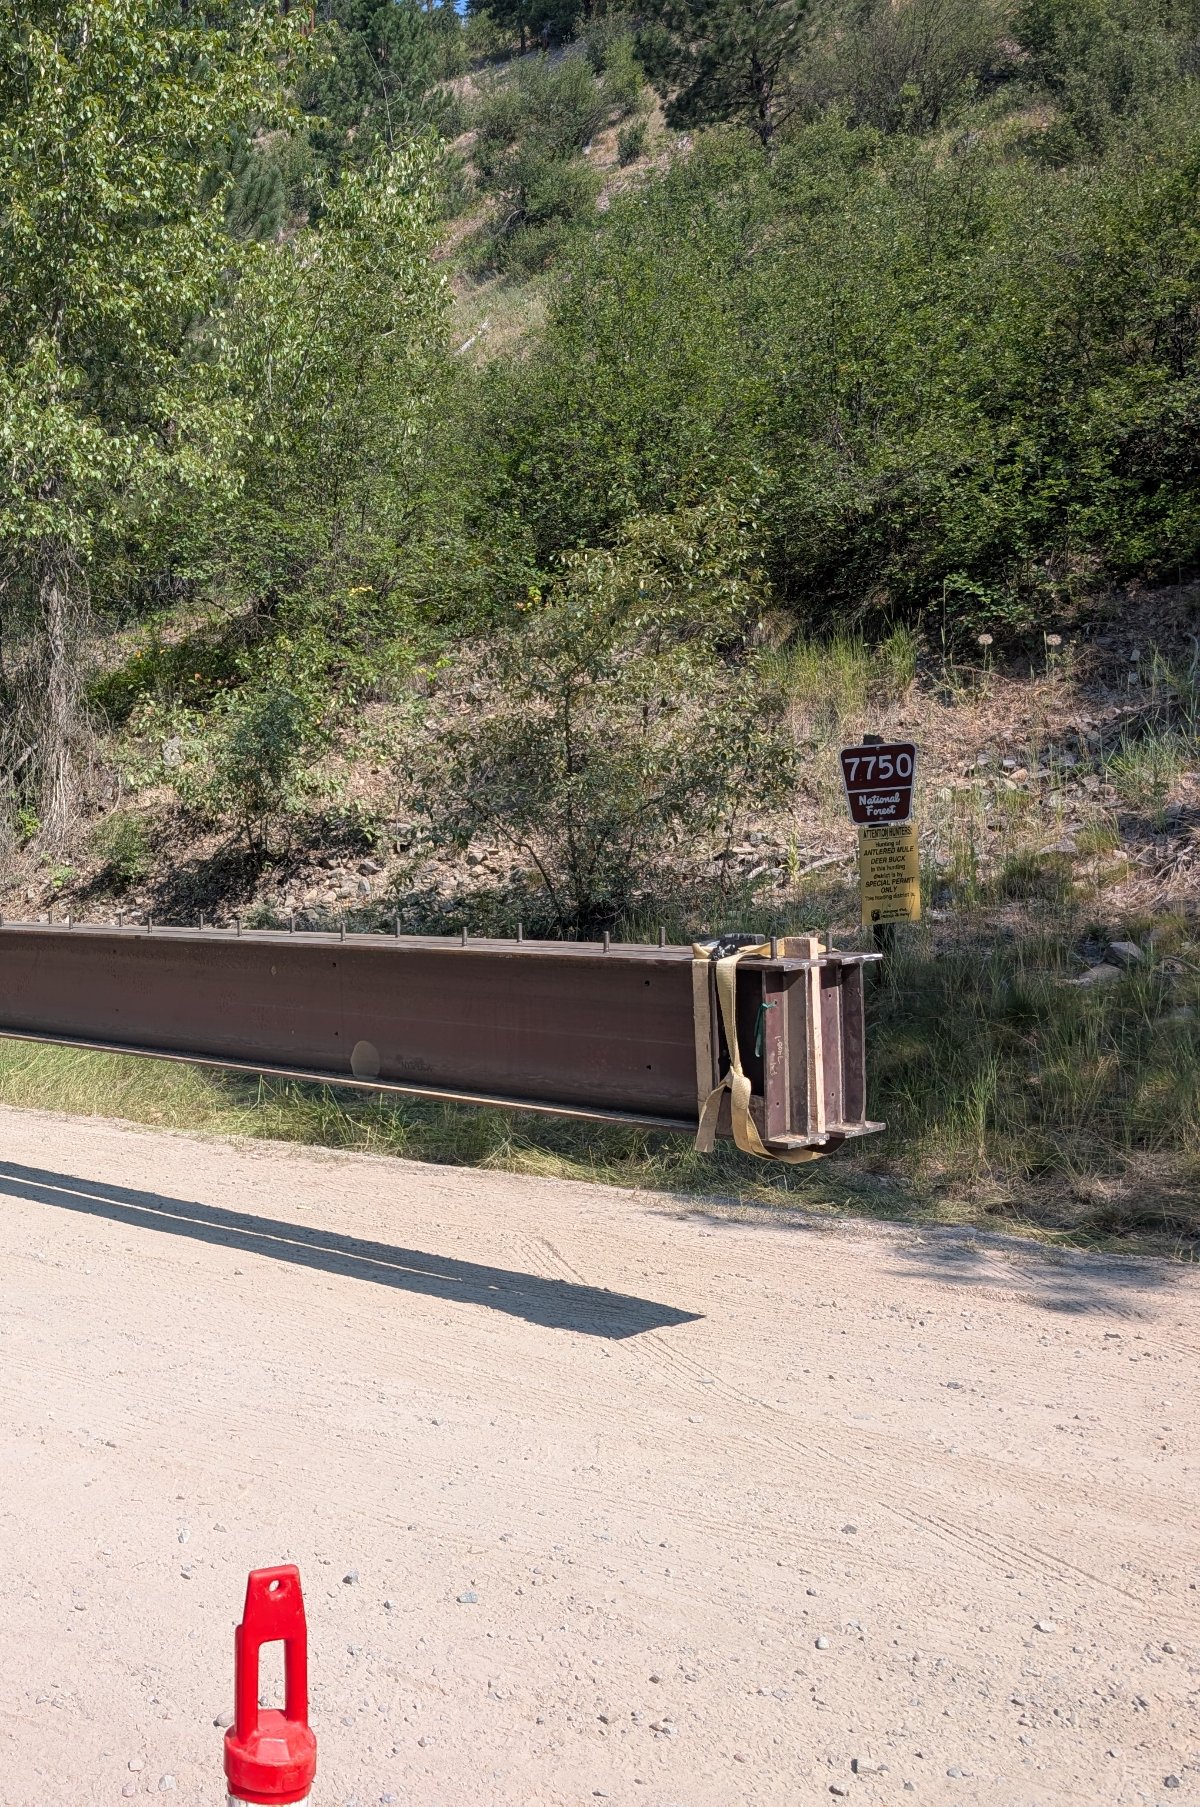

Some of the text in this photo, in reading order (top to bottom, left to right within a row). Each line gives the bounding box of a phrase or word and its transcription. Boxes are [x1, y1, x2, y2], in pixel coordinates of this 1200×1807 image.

[844, 753, 912, 782] 7750
[858, 792, 901, 806] National
[865, 805, 897, 817] Forest
[863, 828, 888, 839] ATTENTION
[863, 845, 914, 856] ANTLERED MULE
[870, 857, 887, 865] DEER
[865, 876, 915, 888] SPECIAL PERMIT
[880, 885, 898, 894] ONLY
